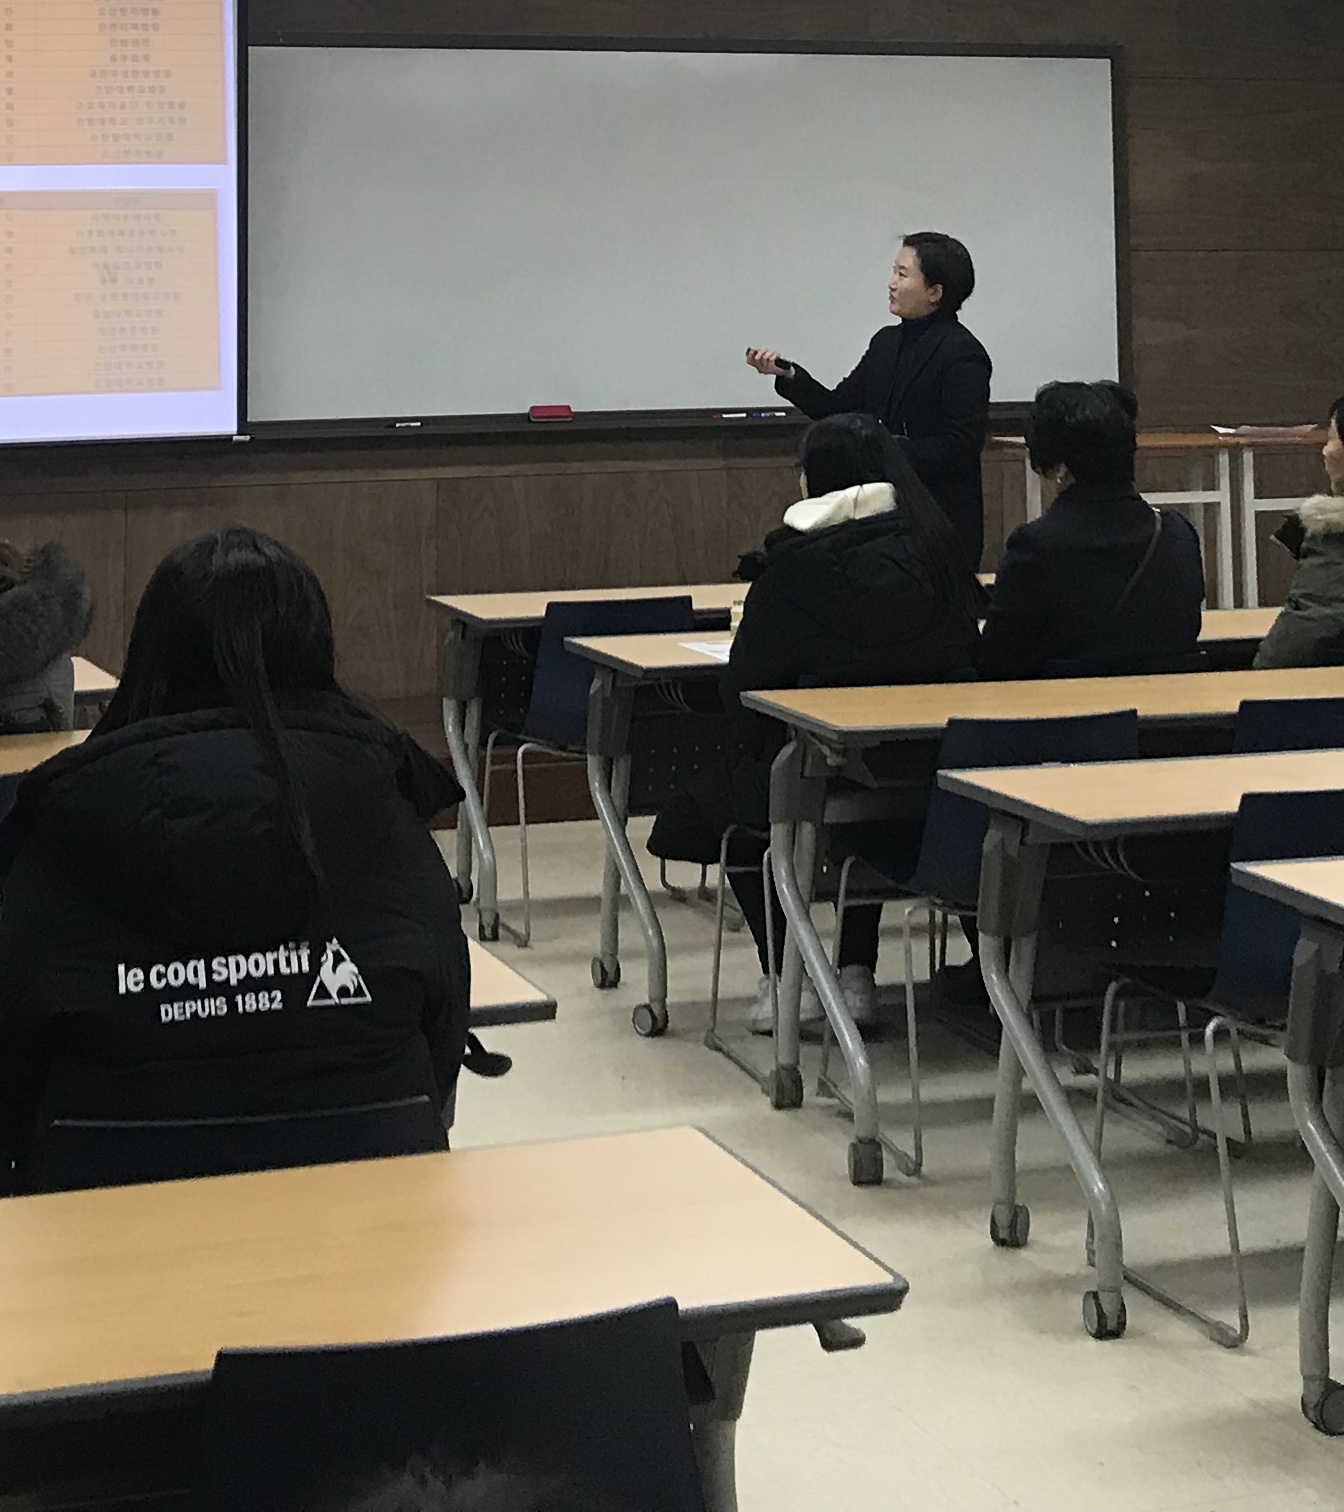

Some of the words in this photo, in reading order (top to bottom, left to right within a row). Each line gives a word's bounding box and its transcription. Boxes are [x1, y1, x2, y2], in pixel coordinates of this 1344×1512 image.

[117, 963, 145, 995] le
[149, 958, 207, 990] coq
[211, 941, 311, 987] sportif
[160, 996, 228, 1024] DEPUIS
[235, 989, 284, 1015] 1882
